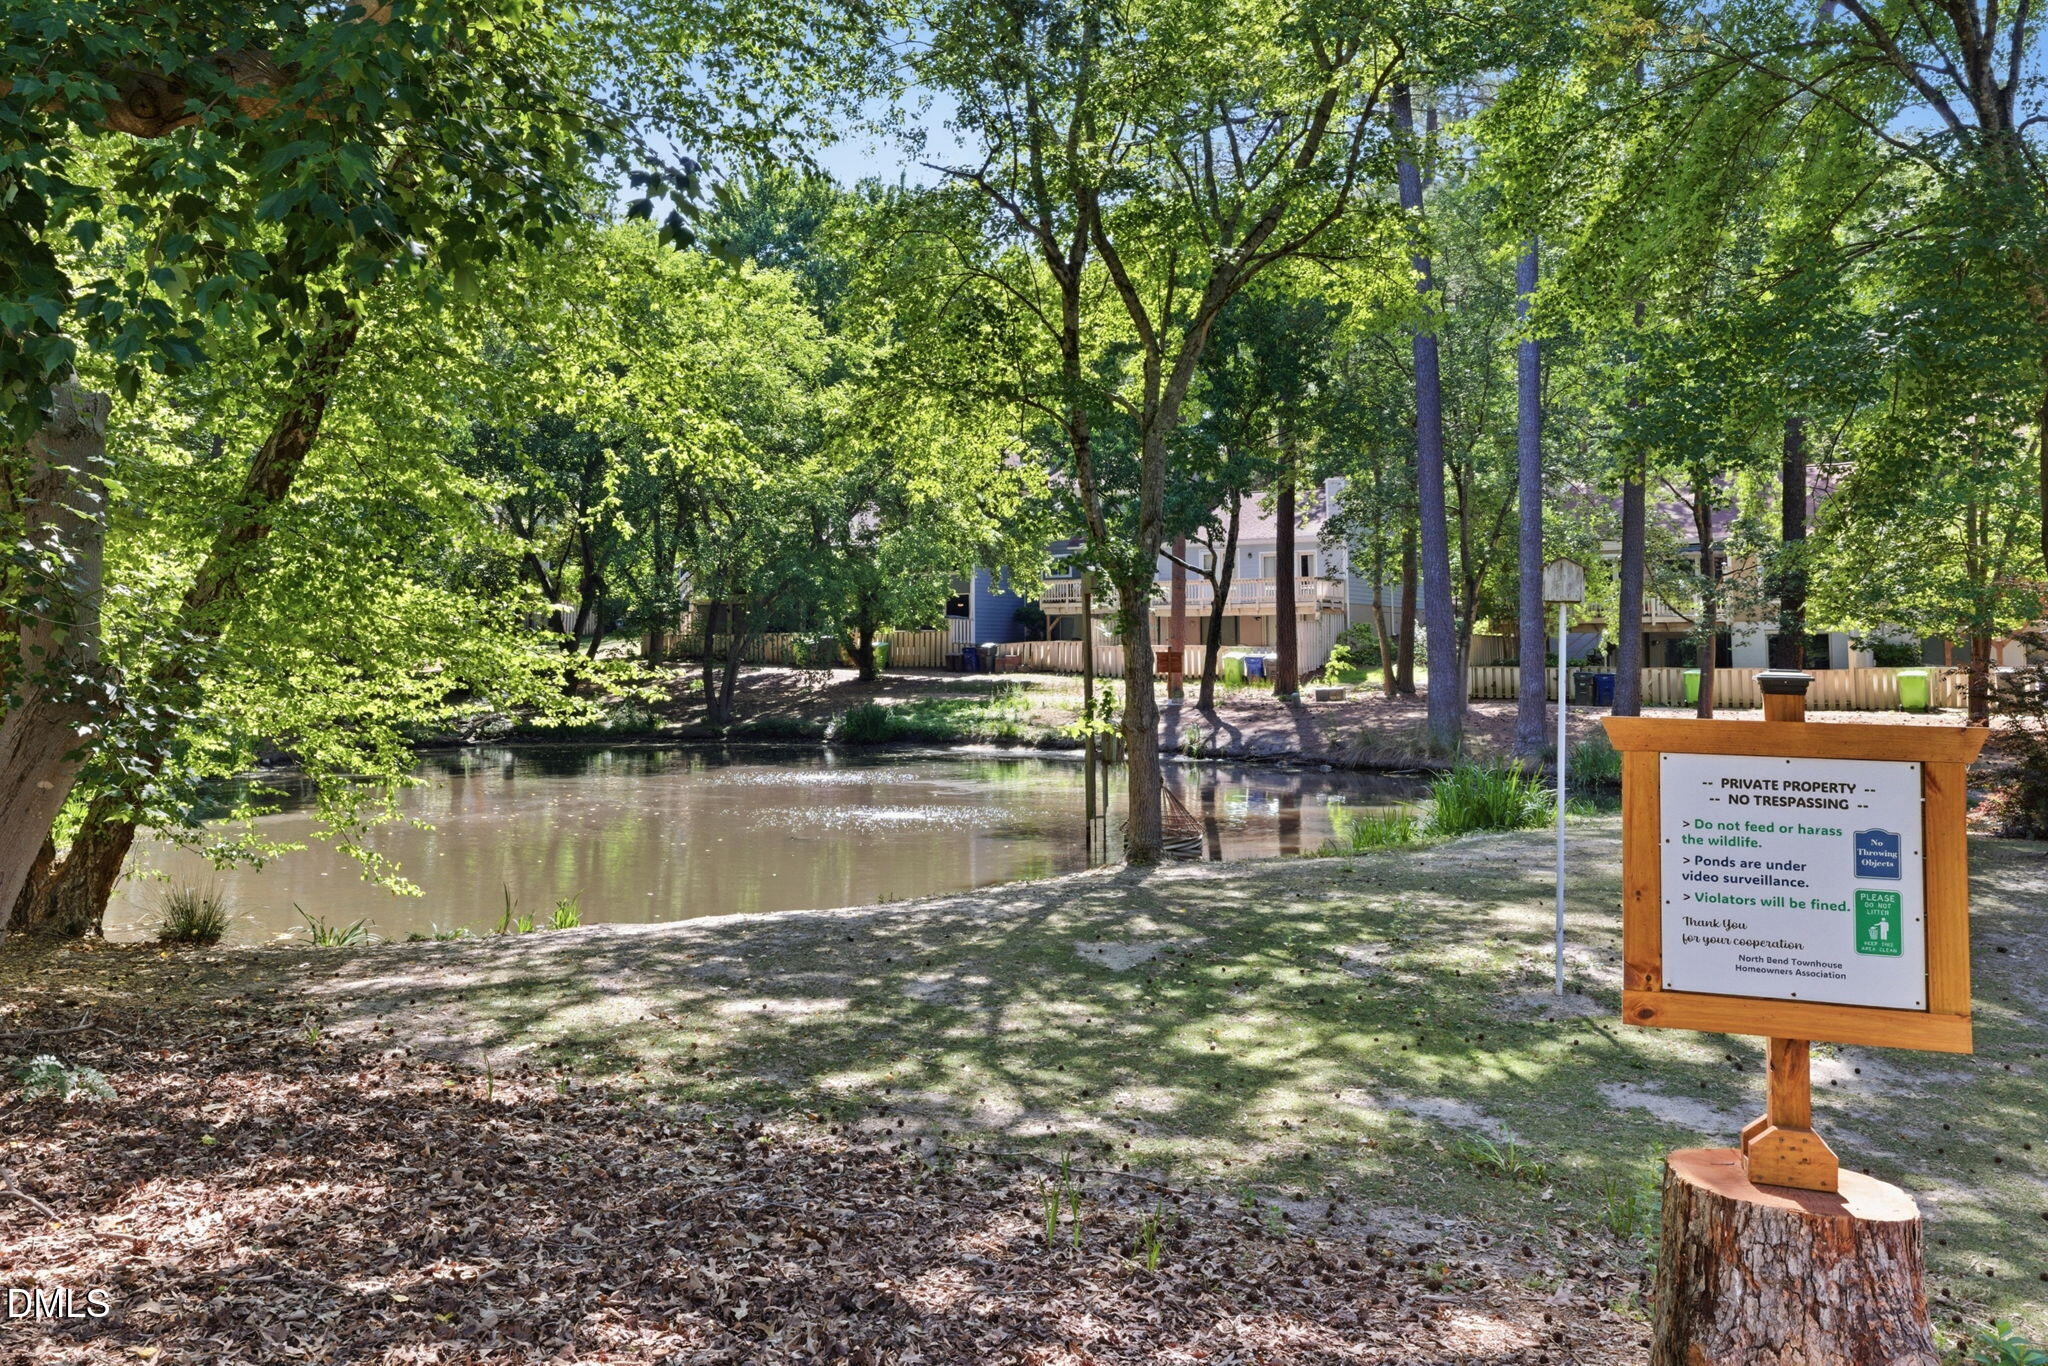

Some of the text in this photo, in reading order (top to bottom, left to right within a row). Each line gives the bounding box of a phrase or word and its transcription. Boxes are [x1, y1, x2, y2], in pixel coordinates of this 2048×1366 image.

[1721, 778, 1779, 791] PRIVATE
[1783, 781, 1856, 794] PROPERTY
[1728, 794, 1750, 806] NO
[1754, 795, 1849, 810] TRESPASSING
[1695, 819, 1713, 830] Do
[1717, 821, 1740, 831] not
[1745, 822, 1774, 833] feed
[1779, 824, 1794, 834] or
[1798, 824, 1842, 837] harass
[1682, 835, 1762, 848] the wildlife.
[1857, 849, 1898, 858] Throwing
[1695, 856, 1736, 868] Ponds
[1740, 859, 1761, 869] are
[1766, 860, 1807, 872] under
[1861, 859, 1894, 868] Objects
[1682, 872, 1809, 888] video surveillance.
[1695, 892, 1756, 906] Violators
[1761, 896, 1785, 908] will
[1789, 897, 1806, 909] be
[1811, 899, 1850, 912] fined.
[1860, 893, 1895, 902] PLEASE
[1682, 916, 1747, 931] Thank You
[1682, 933, 1804, 950] for your cooperation
[1739, 954, 1842, 969] North Bend Townhouse
[1735, 965, 1846, 980] Homeowners Association
